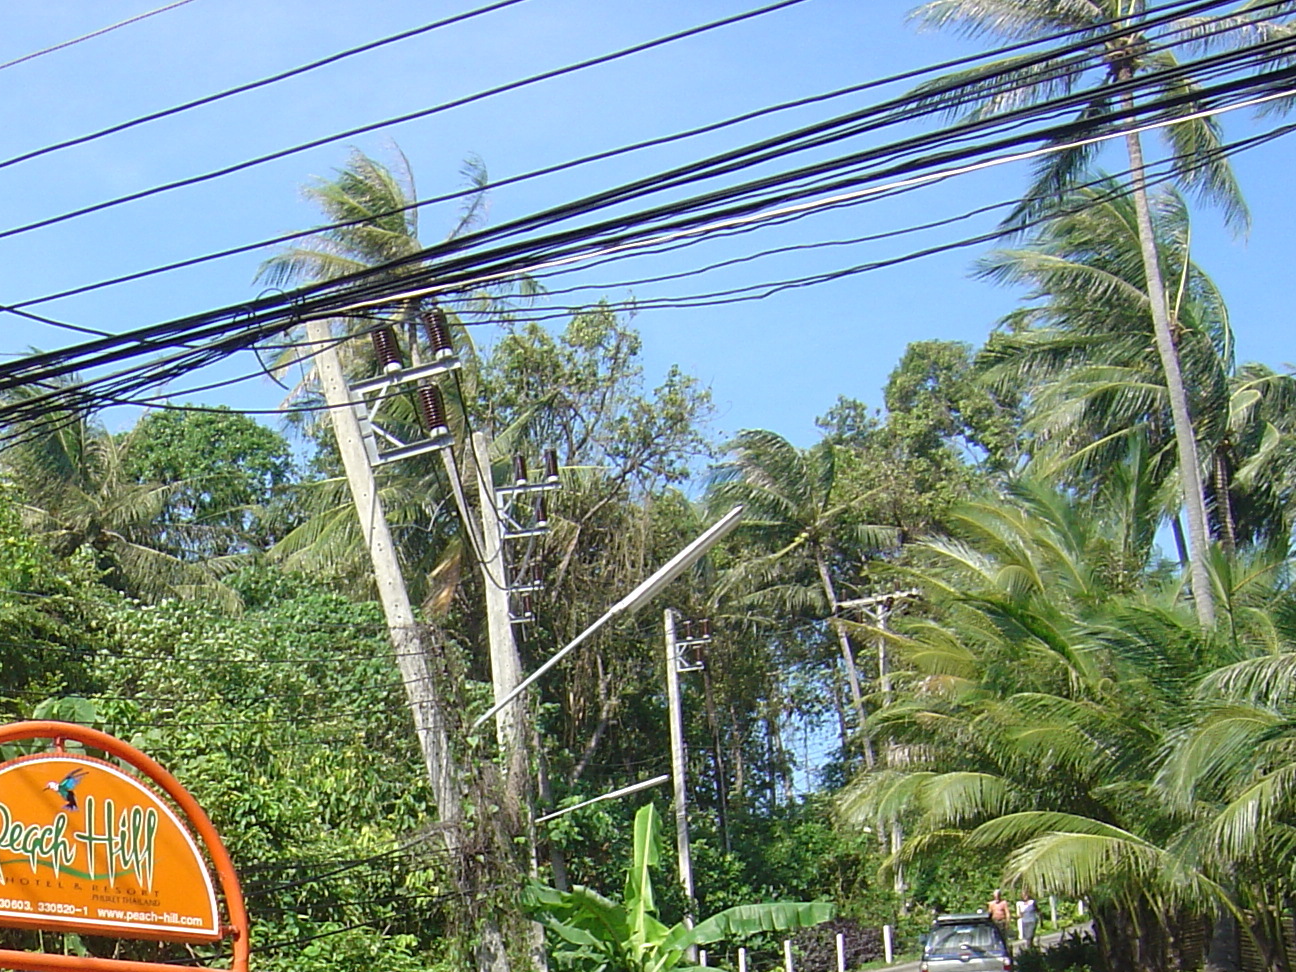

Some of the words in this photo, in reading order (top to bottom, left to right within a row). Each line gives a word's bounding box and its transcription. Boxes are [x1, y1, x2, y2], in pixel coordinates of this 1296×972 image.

[75, 796, 159, 893] Hill
[5, 876, 64, 889] HOTEL
[92, 884, 160, 898] RESORT
[97, 907, 204, 927] www.peach-hill.com
